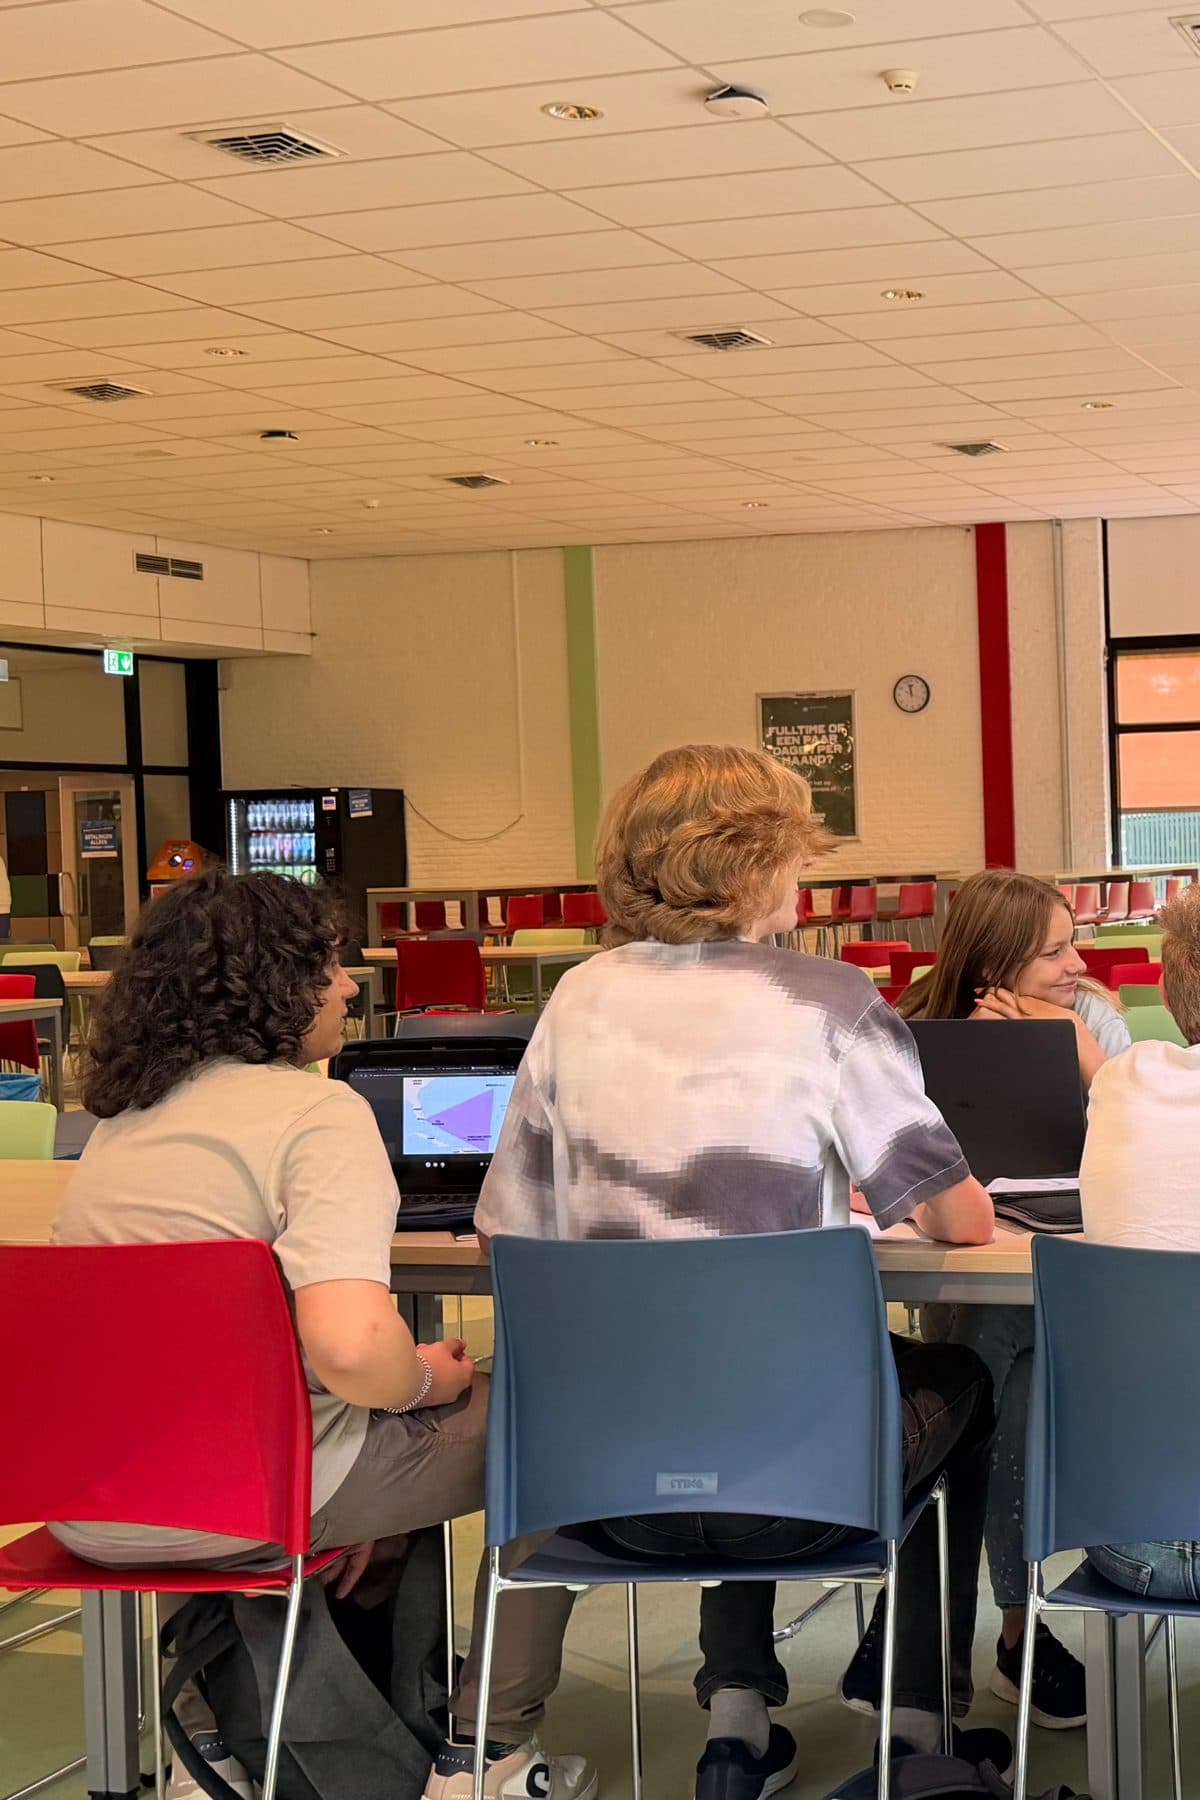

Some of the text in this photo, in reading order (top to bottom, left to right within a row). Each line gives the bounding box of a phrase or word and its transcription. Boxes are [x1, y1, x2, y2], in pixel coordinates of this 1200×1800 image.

[768, 724, 826, 736] FULLTIME
[776, 734, 838, 746] EEN PAAR
[817, 743, 843, 754] PER
